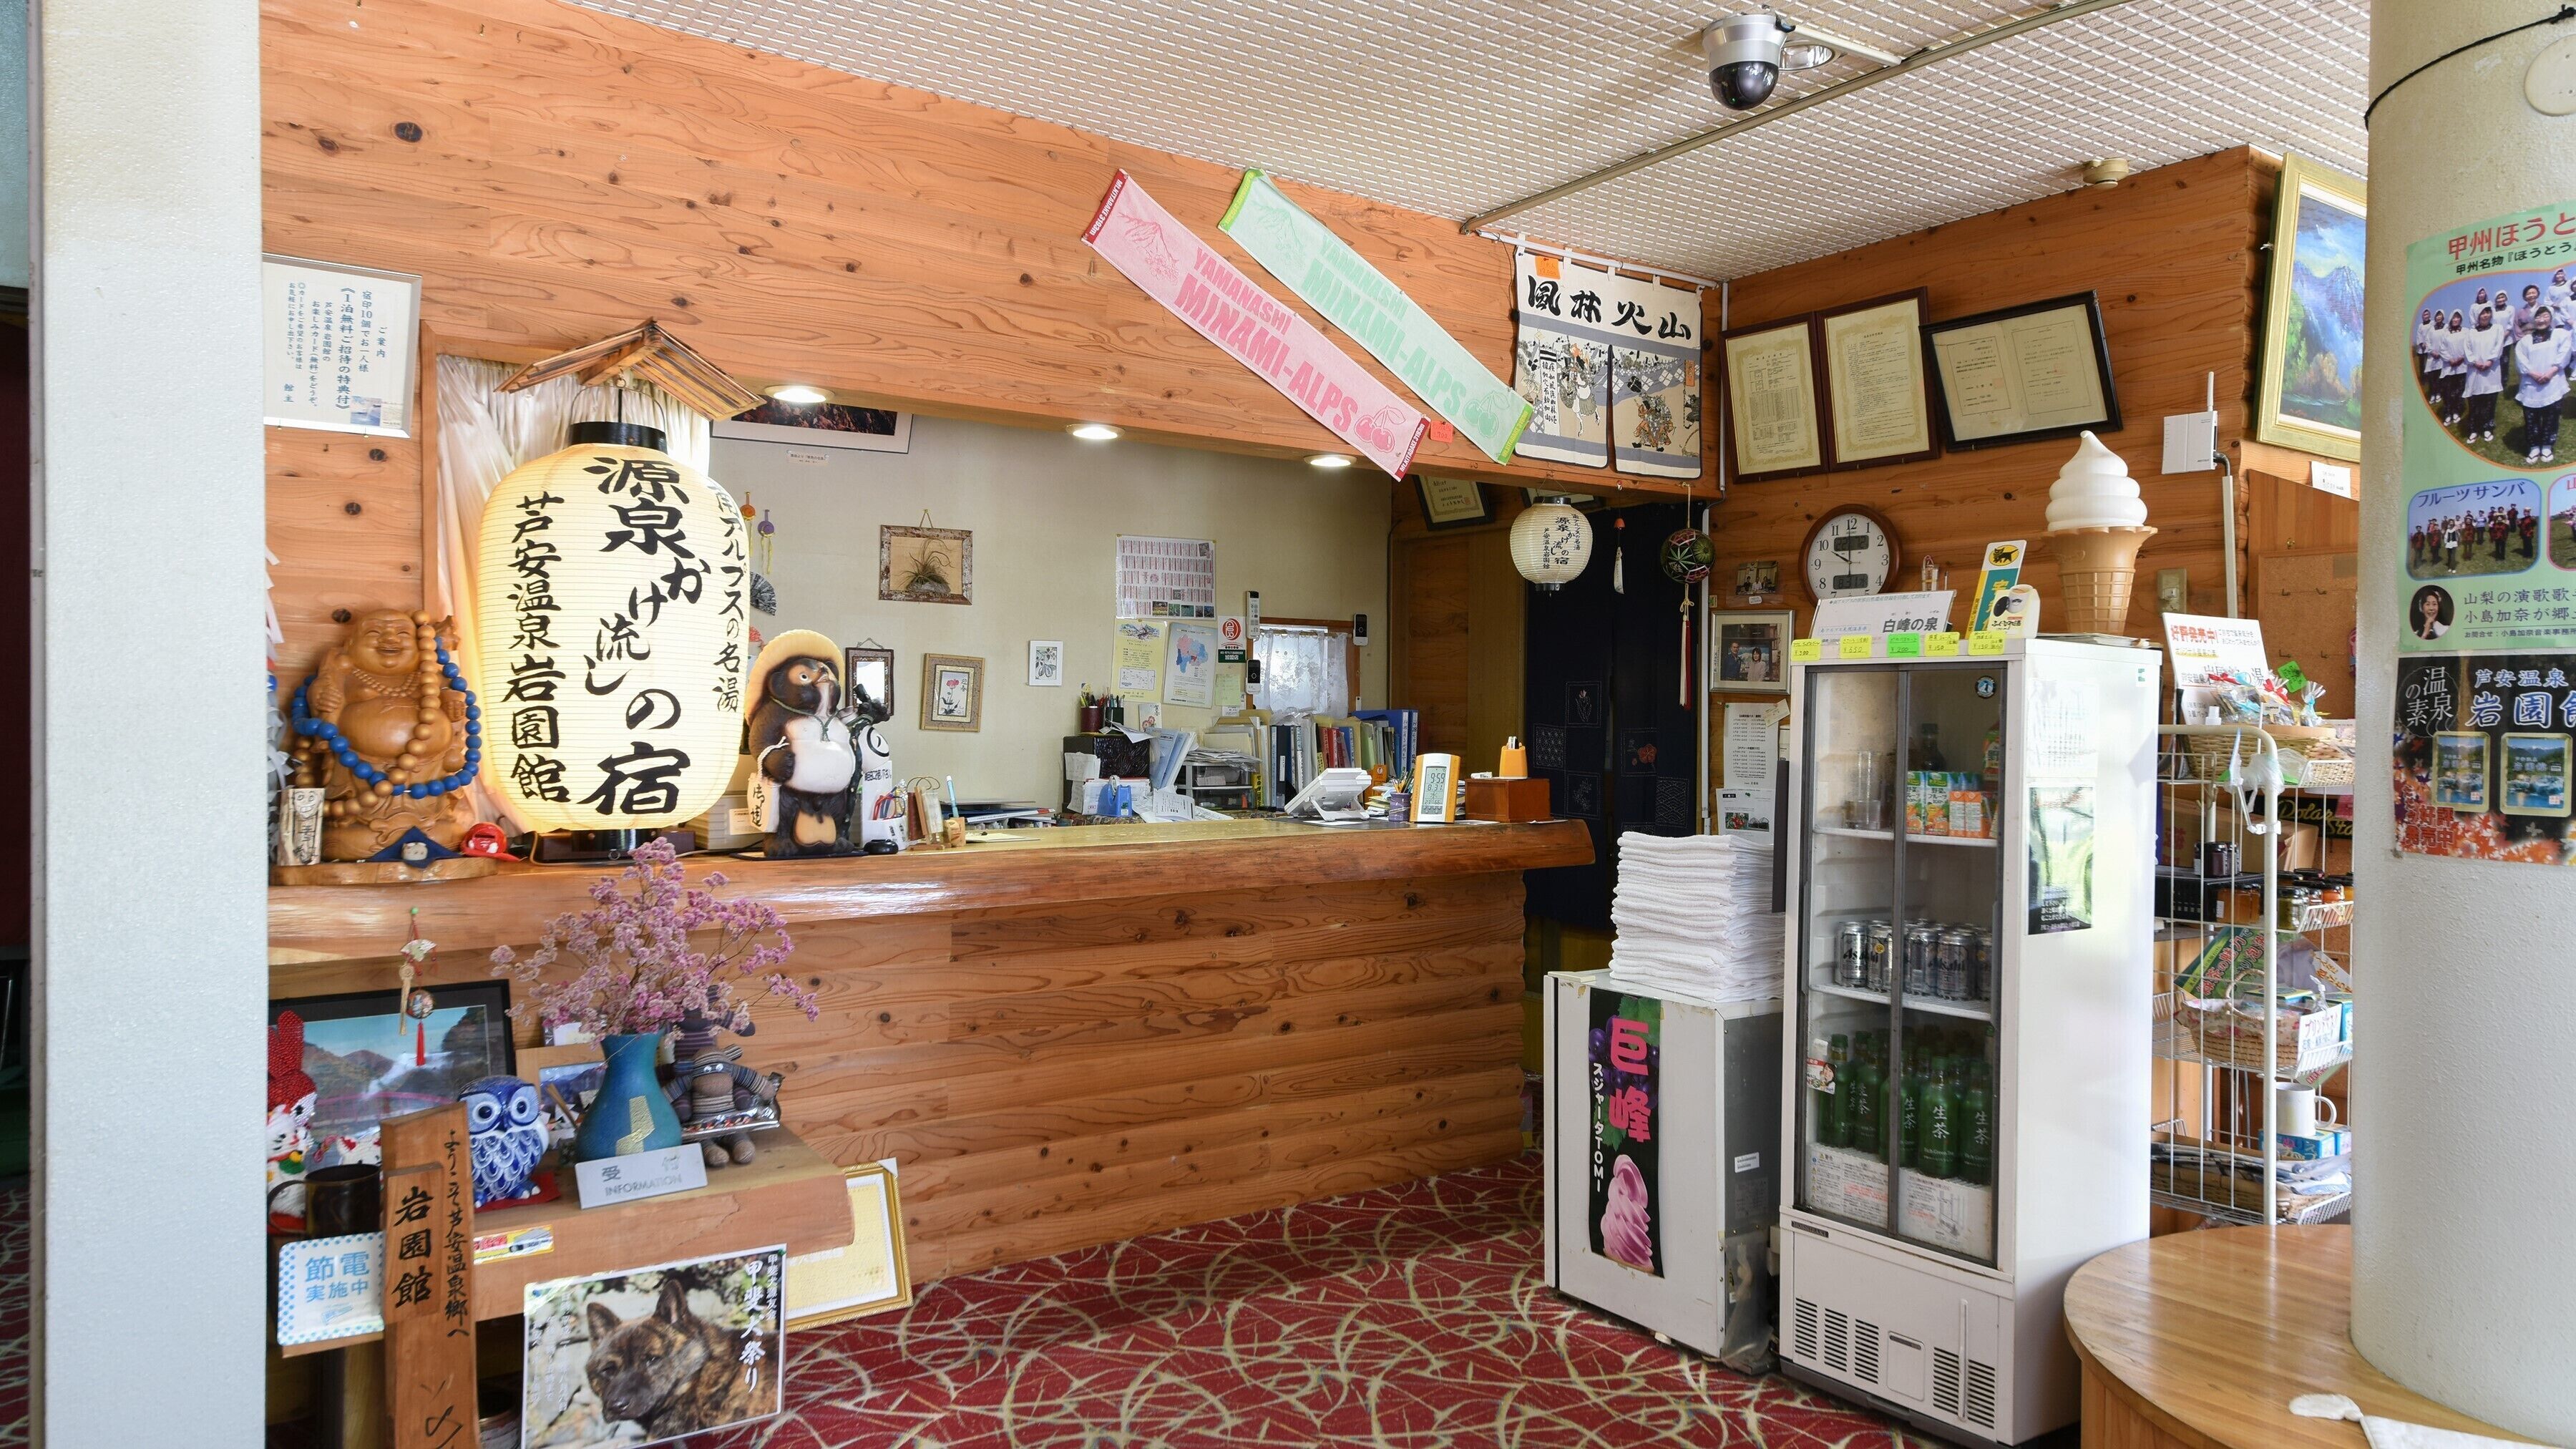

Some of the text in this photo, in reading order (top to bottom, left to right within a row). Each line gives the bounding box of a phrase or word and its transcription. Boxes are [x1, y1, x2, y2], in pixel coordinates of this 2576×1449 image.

[2448, 212, 2576, 260] 甲州ほうと
[1194, 247, 1292, 336] YAMANASHI
[1322, 234, 1408, 320] YAMANASHI
[1528, 275, 1692, 340] 風林火山
[358, 290, 373, 373] 宿印10個でお一人様
[376, 326, 387, 358] ご案内
[1302, 258, 1466, 416] MINAMI-ALPS
[1174, 273, 1358, 432] MINAMI-ALPS
[1831, 525, 1839, 536] 11
[1847, 517, 1858, 530] 12
[1865, 522, 1870, 533] 1
[1551, 517, 1576, 565] 源泉かけ流しの宿
[1818, 540, 1829, 551] 10
[1877, 535, 1883, 546] 2
[1814, 559, 1821, 570] 9
[1881, 554, 1888, 565] 3
[708, 475, 746, 713] 南アルプスの名湯
[1819, 577, 1826, 589] 8
[1875, 575, 1883, 586] 4
[2464, 587, 2576, 606] 山梨の演歌歌
[1883, 617, 1938, 633] 白峰の泉
[2464, 606, 2576, 625] 小島加奈が郷
[501, 491, 571, 804] 芦安温泉岩園館
[577, 456, 711, 815] 源泉かけ流しの宿
[2474, 668, 2569, 688] 芦安温泉
[1430, 773, 1445, 784] 9:59
[1609, 1019, 1652, 1143] 巨峰
[1903, 1096, 1917, 1129] 生茶
[1932, 1106, 1951, 1139] 生茶
[1975, 1111, 1989, 1145] 生茶
[602, 1165, 621, 1181] 受
[605, 1174, 682, 1197] INFORMATION
[391, 1185, 434, 1309] 岩園館
[444, 1128, 471, 1338] ようこそ芦安温泉郷へ
[305, 1250, 370, 1283] 節電
[305, 1279, 370, 1304] 実施中
[739, 1260, 766, 1393] 甲斐犬祭り
